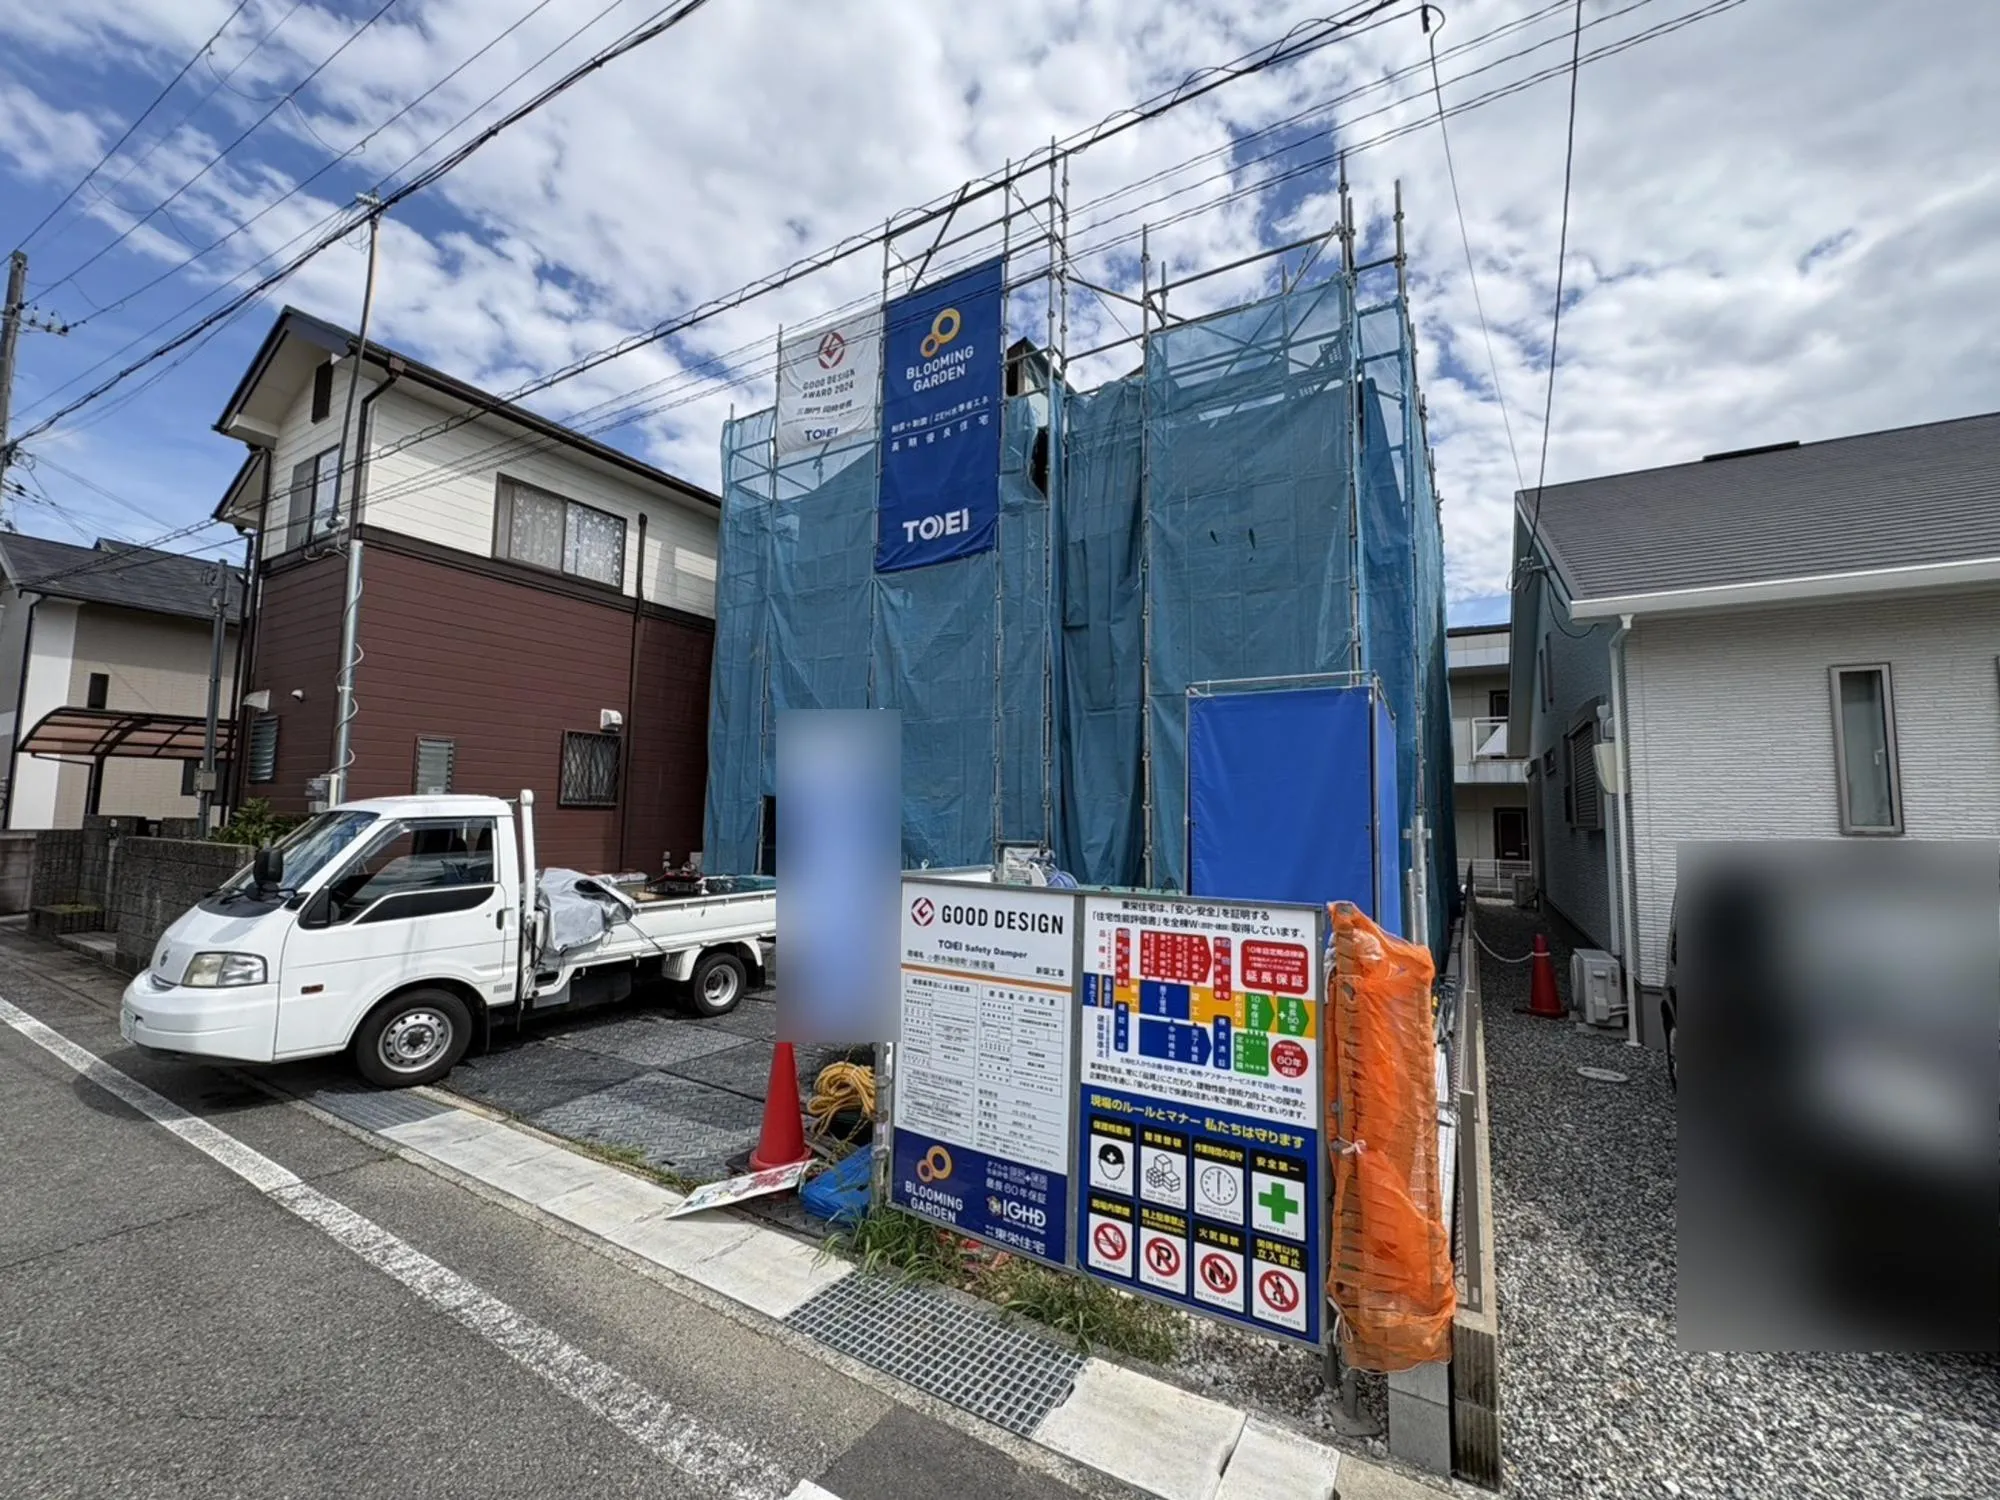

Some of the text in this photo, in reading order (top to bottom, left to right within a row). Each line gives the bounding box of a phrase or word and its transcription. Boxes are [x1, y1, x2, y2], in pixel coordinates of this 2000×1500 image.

[906, 345, 974, 379] BLOOMING
[913, 364, 966, 392] GARDEN
[802, 387, 832, 399] AWARD
[942, 905, 1064, 935] GOOD DESIGN
[965, 944, 991, 957] Safety
[994, 947, 1028, 959] Damper
[1246, 971, 1304, 987] 延長保証
[1090, 1094, 1305, 1149] 現場のルールとマナー 私たちは守ります
[1256, 1157, 1300, 1172] 安全第一
[905, 1180, 963, 1211] BLOOMING
[911, 1197, 956, 1224] GARDEN
[995, 1228, 1045, 1255] 東栄住宅
[1198, 1228, 1240, 1247] 火気厳禁
[1257, 1249, 1300, 1269] 立入禁止
